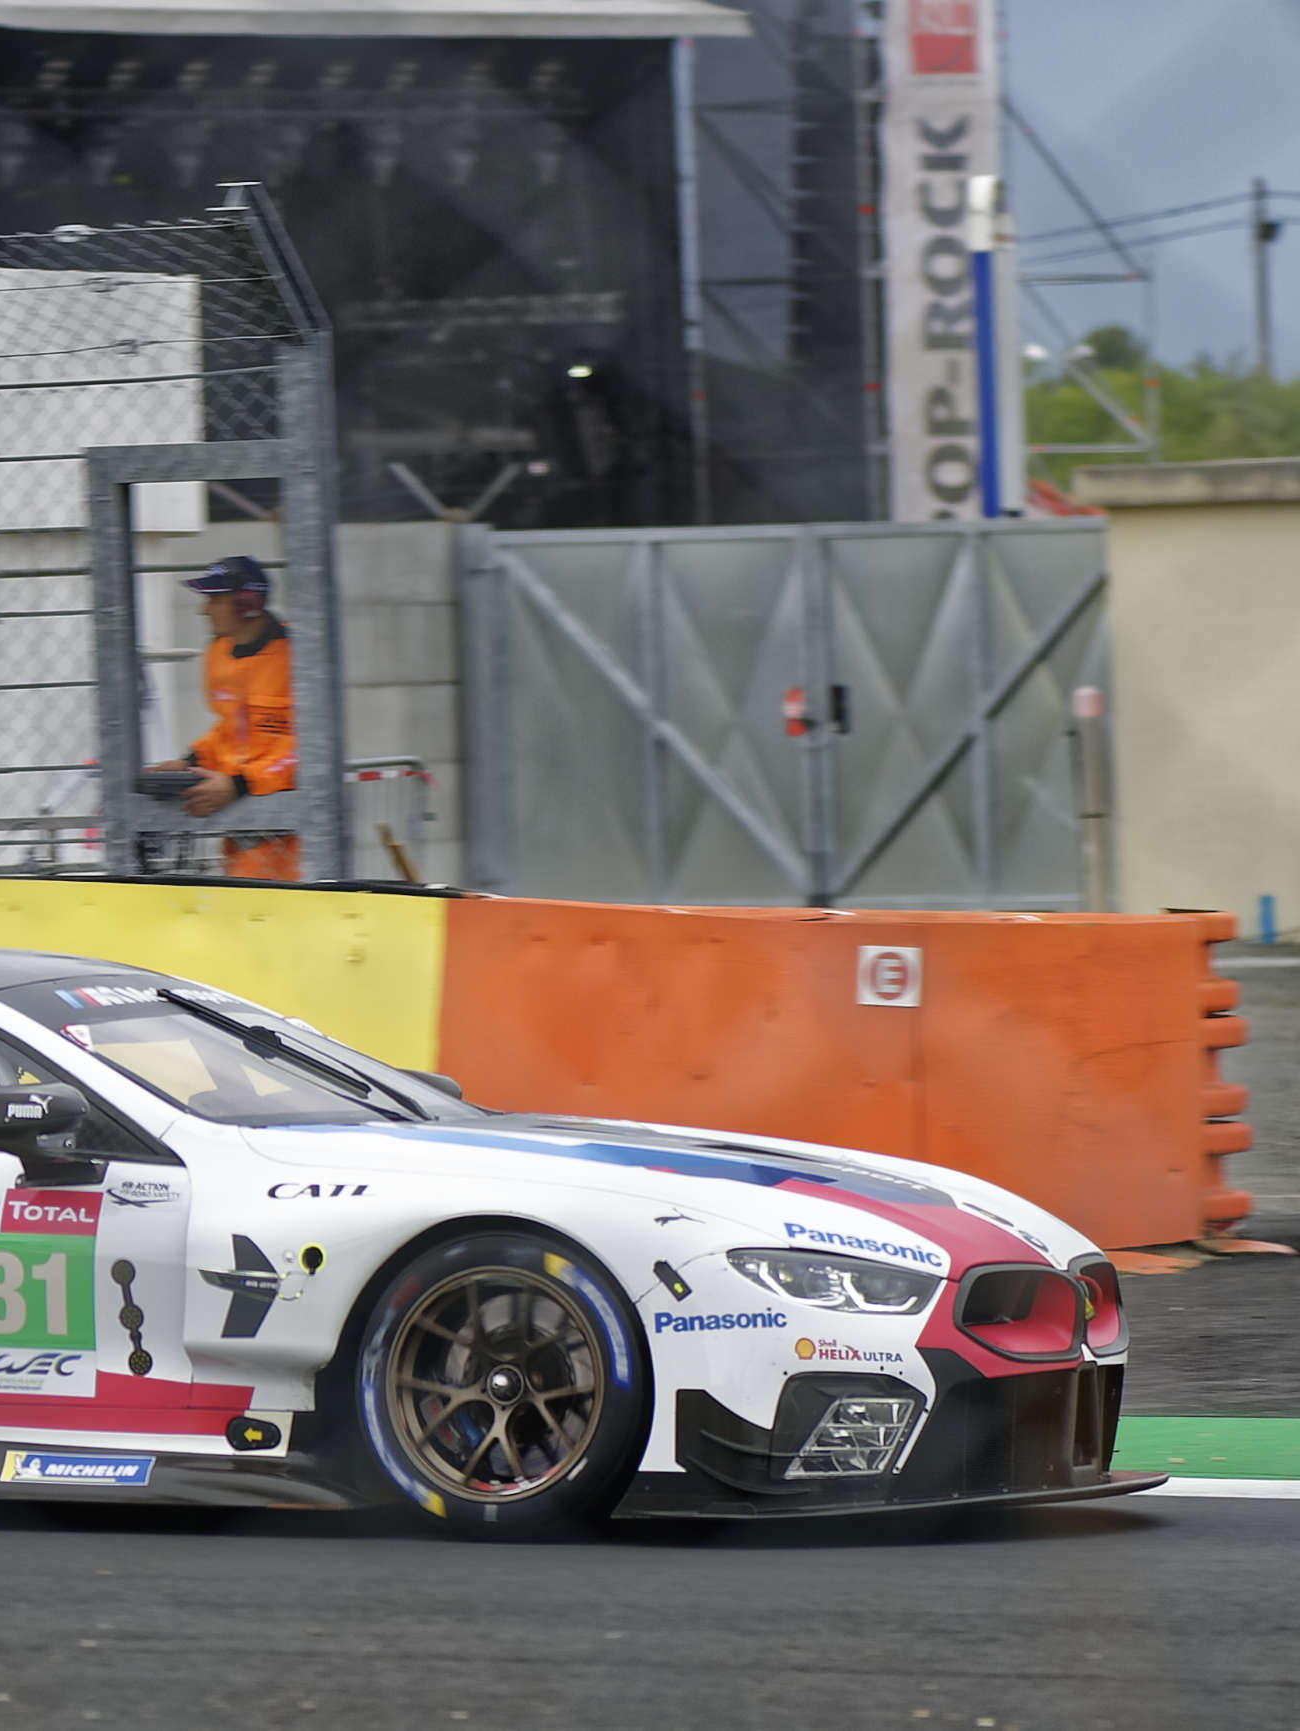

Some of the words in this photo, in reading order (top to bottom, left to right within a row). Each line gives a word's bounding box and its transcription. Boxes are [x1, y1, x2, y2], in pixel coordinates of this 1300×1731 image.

[912, 113, 978, 520] OP-ROCK
[8, 1200, 95, 1224] TOTAL
[783, 1220, 944, 1269] Panasonic
[654, 1306, 788, 1334] Panasonic
[818, 1345, 862, 1361] HELIX
[863, 1351, 904, 1363] ULTRA
[44, 1463, 140, 1477] MICHELIN
